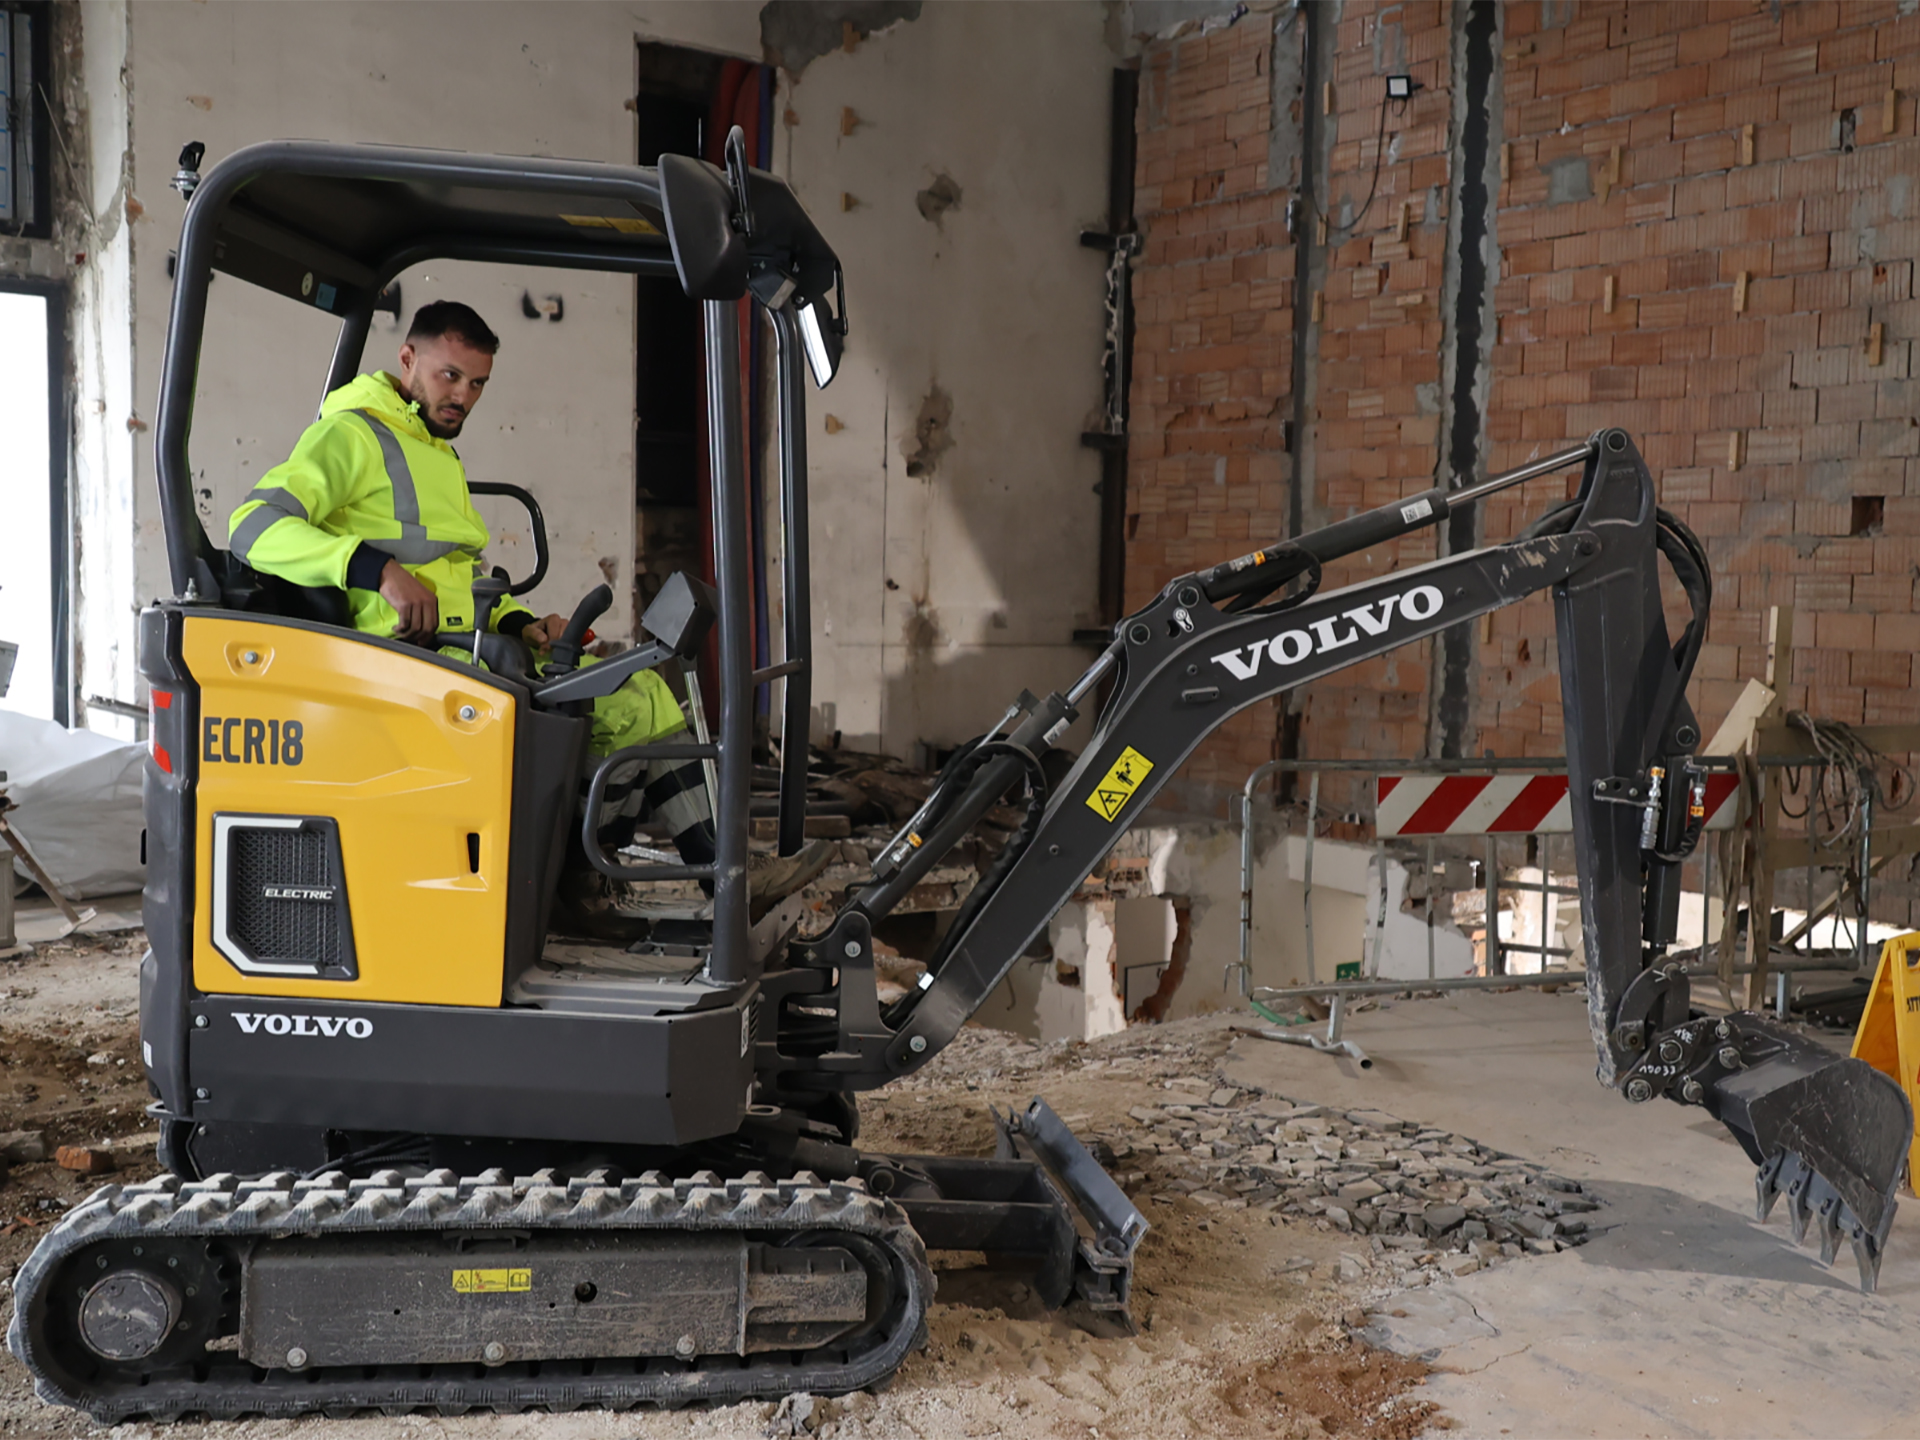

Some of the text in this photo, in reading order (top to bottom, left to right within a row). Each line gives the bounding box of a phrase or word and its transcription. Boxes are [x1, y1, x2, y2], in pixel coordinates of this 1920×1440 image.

[1210, 585, 1444, 681] VOLVO
[203, 716, 303, 766] ECR18
[264, 888, 333, 900] ELECTRIC
[1906, 995, 1920, 1013] ATT
[231, 1012, 374, 1039] VOLVO
